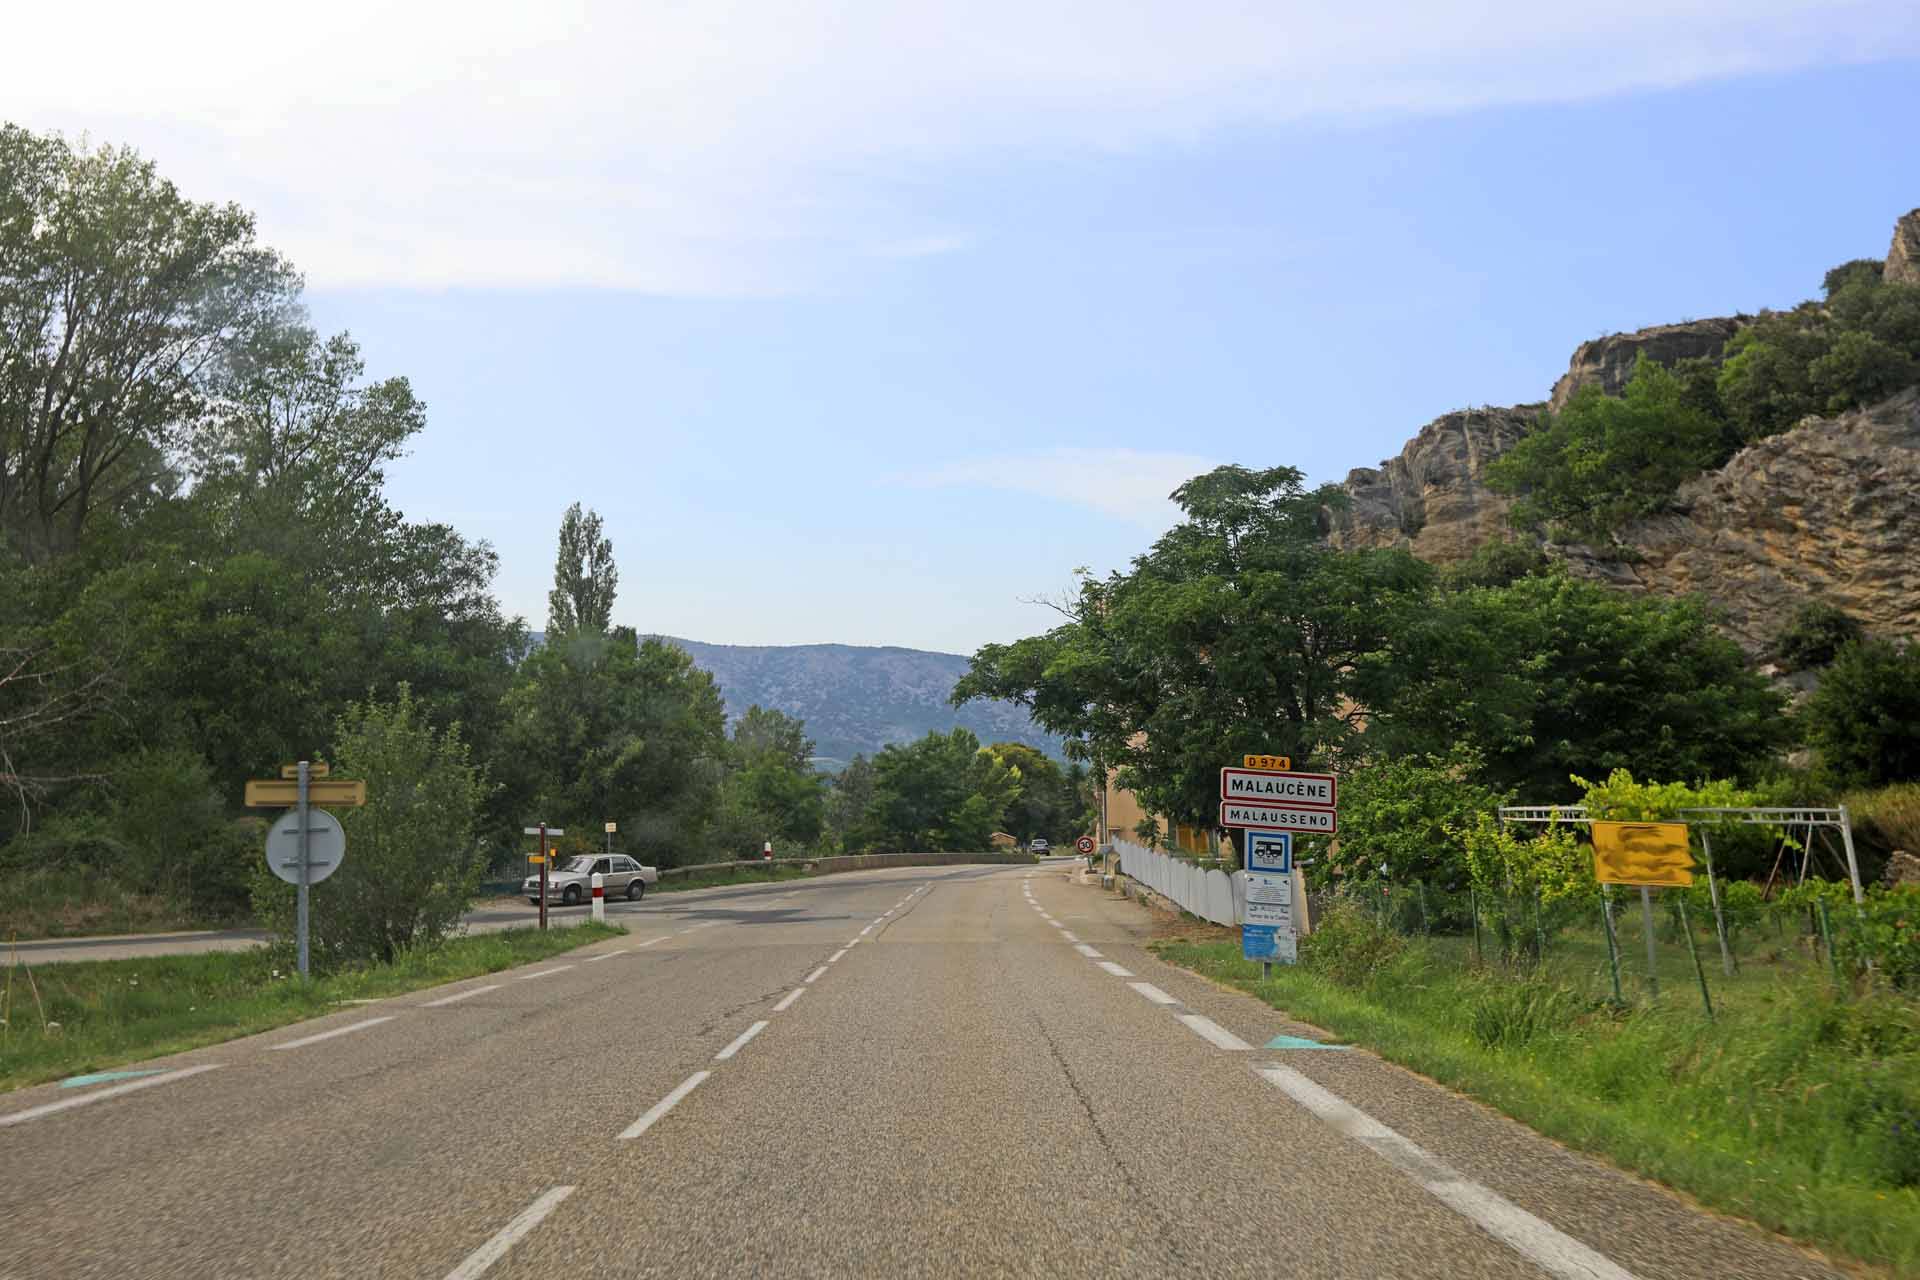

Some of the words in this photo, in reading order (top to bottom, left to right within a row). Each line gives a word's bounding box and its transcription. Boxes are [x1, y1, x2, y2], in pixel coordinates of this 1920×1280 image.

[1248, 757, 1256, 767] D
[1260, 758, 1286, 768] 974
[1231, 779, 1327, 798] MALAUCÈNE
[1230, 810, 1328, 826] MALAUSSENO
[1080, 841, 1090, 849] 30
